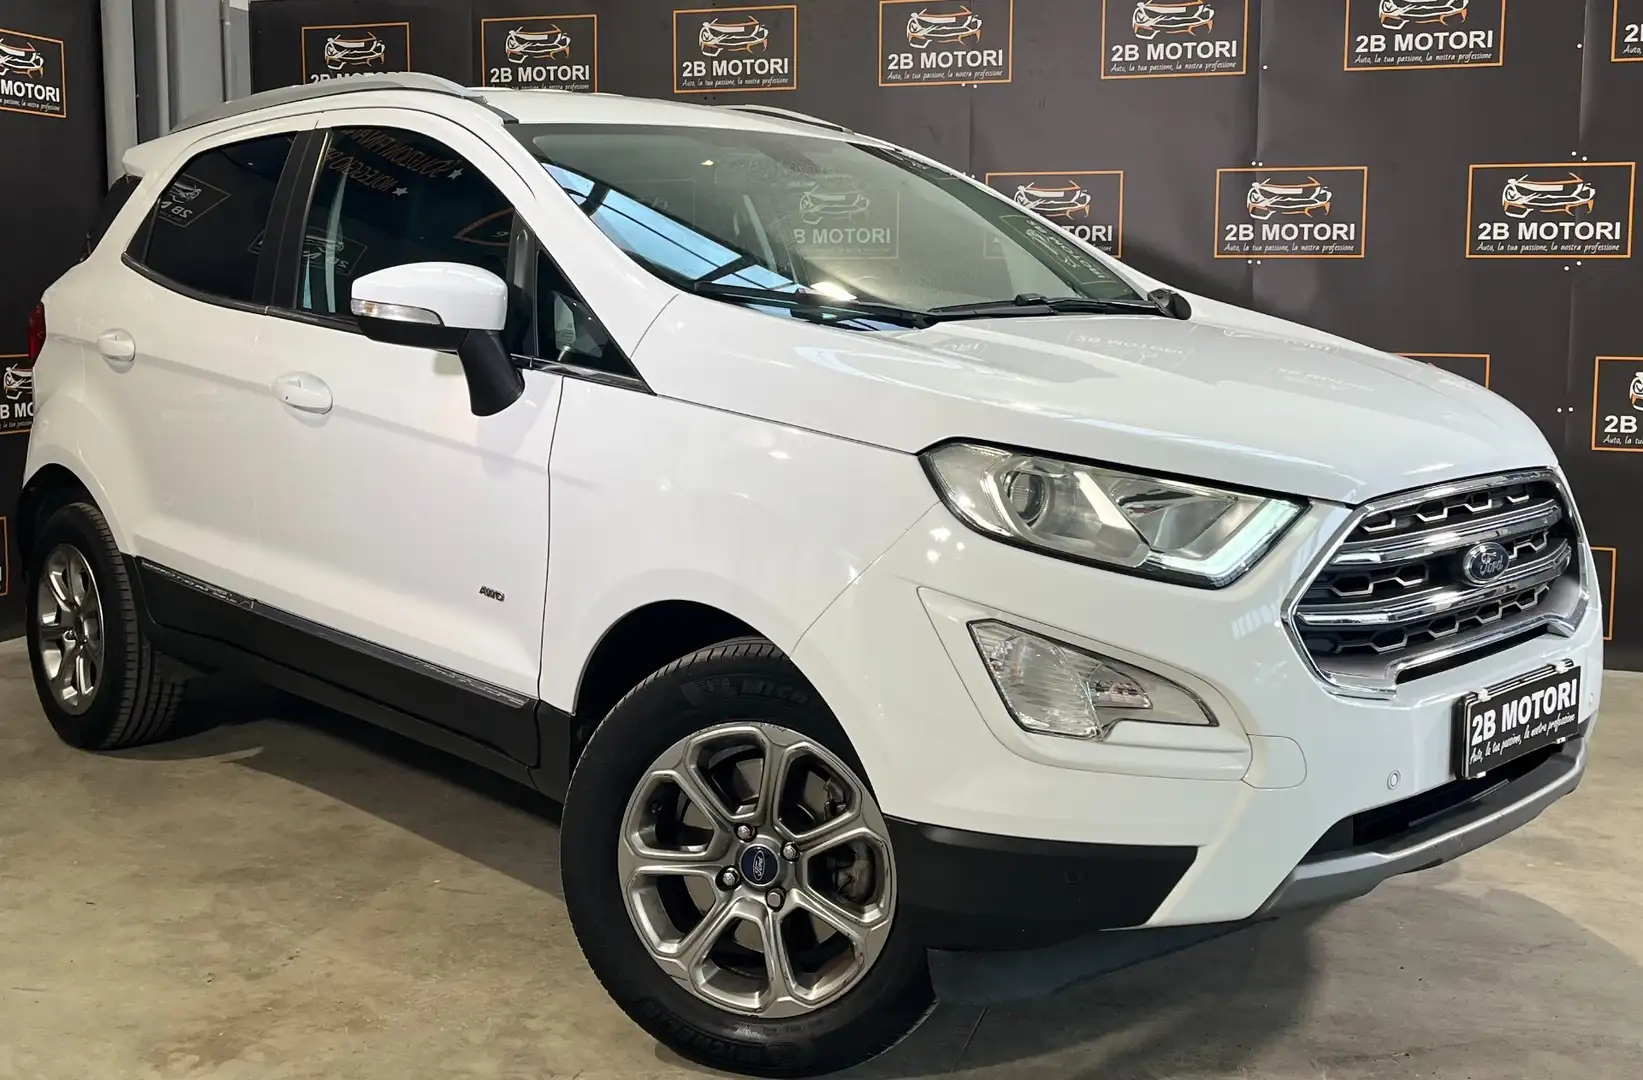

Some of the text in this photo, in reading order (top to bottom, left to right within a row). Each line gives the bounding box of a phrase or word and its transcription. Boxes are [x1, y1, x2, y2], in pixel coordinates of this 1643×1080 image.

[1356, 30, 1492, 52] 2B MOTORI
[888, 50, 1002, 69] 2B MOTORI
[1111, 40, 1236, 61] 2B MOTORI
[1375, 54, 1381, 63] la
[1426, 53, 1432, 61] la
[490, 65, 589, 83] 2B MOTORI
[682, 58, 788, 77] 2B MOTORI
[904, 71, 910, 79] la
[948, 70, 953, 78] la
[1129, 62, 1135, 71] la
[1176, 61, 1182, 69] la
[1, 79, 60, 102] MOTORI
[793, 228, 891, 244] B MOTORI
[1061, 225, 1112, 241] TORI
[1225, 223, 1355, 241] 2B MOTORI
[1478, 222, 1621, 240] 2B MOTORI
[1292, 243, 1298, 251] la
[1498, 242, 1504, 251] la
[1551, 241, 1558, 251] la
[0, 404, 10, 419] B
[1604, 415, 1637, 433] 2B
[1603, 434, 1621, 445] Auto,
[1625, 435, 1631, 444] la
[1480, 552, 1503, 576] Ford
[479, 585, 505, 602] AWD
[1472, 678, 1577, 746] 2B MOTORI
